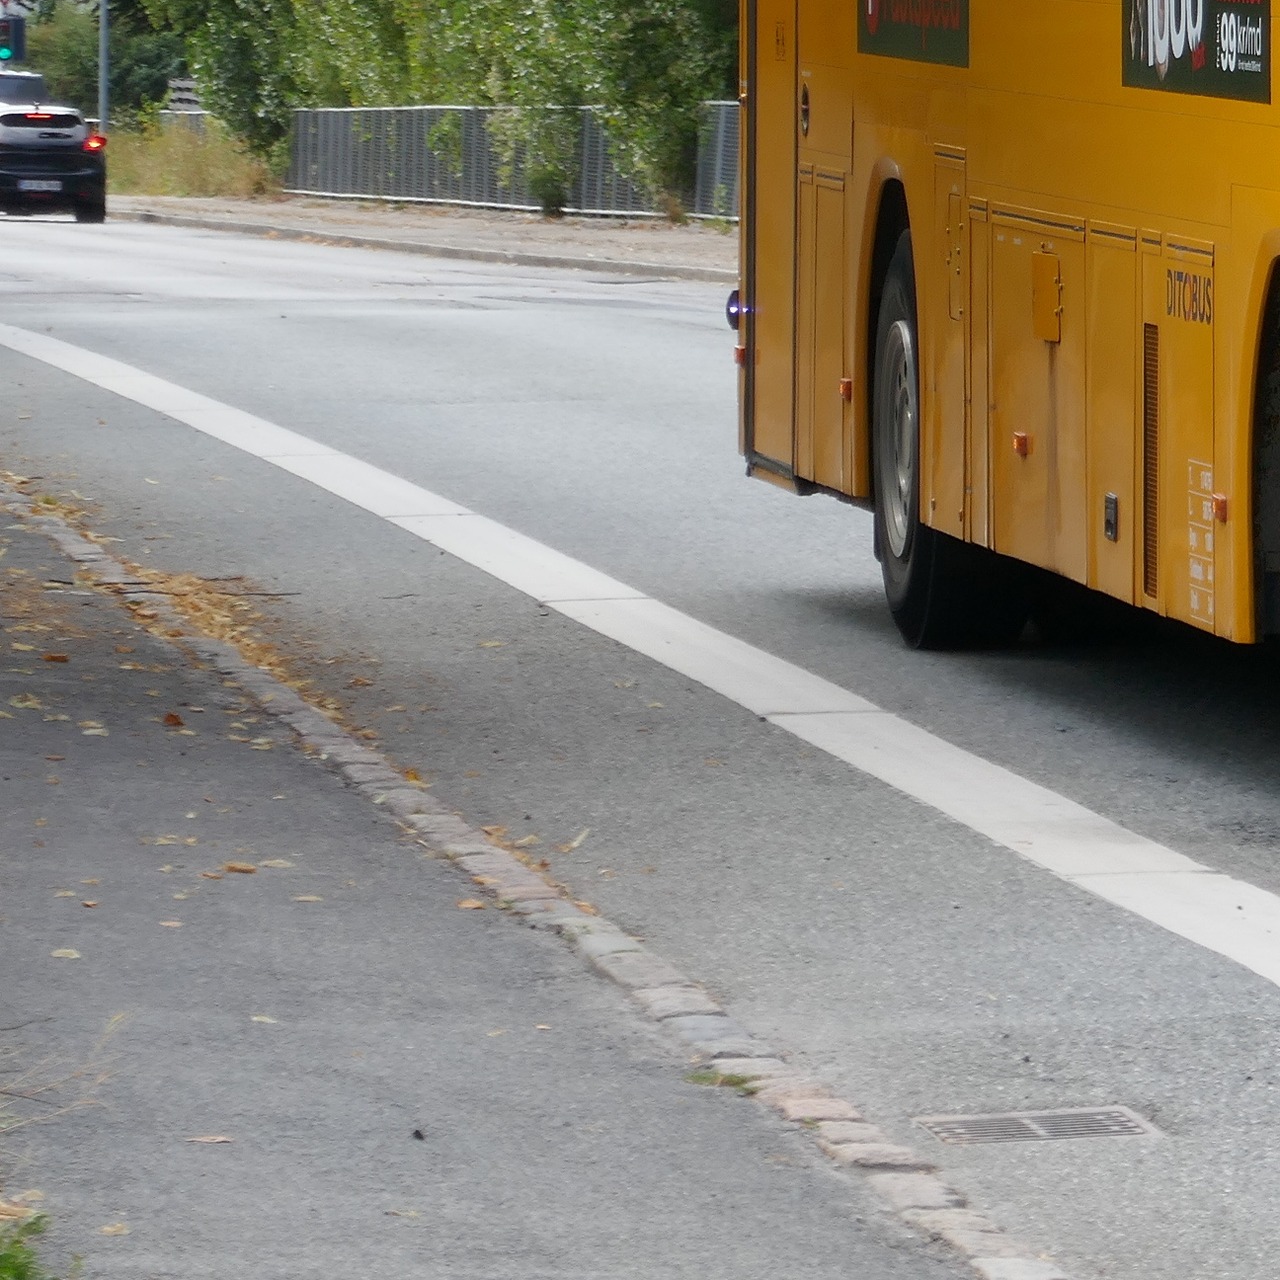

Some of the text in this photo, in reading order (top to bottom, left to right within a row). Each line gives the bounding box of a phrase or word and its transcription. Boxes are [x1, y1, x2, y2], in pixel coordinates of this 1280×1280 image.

[1220, 12, 1237, 72] 99
[1237, 16, 1262, 57] kr/md
[1166, 268, 1213, 326] DITOBUS
